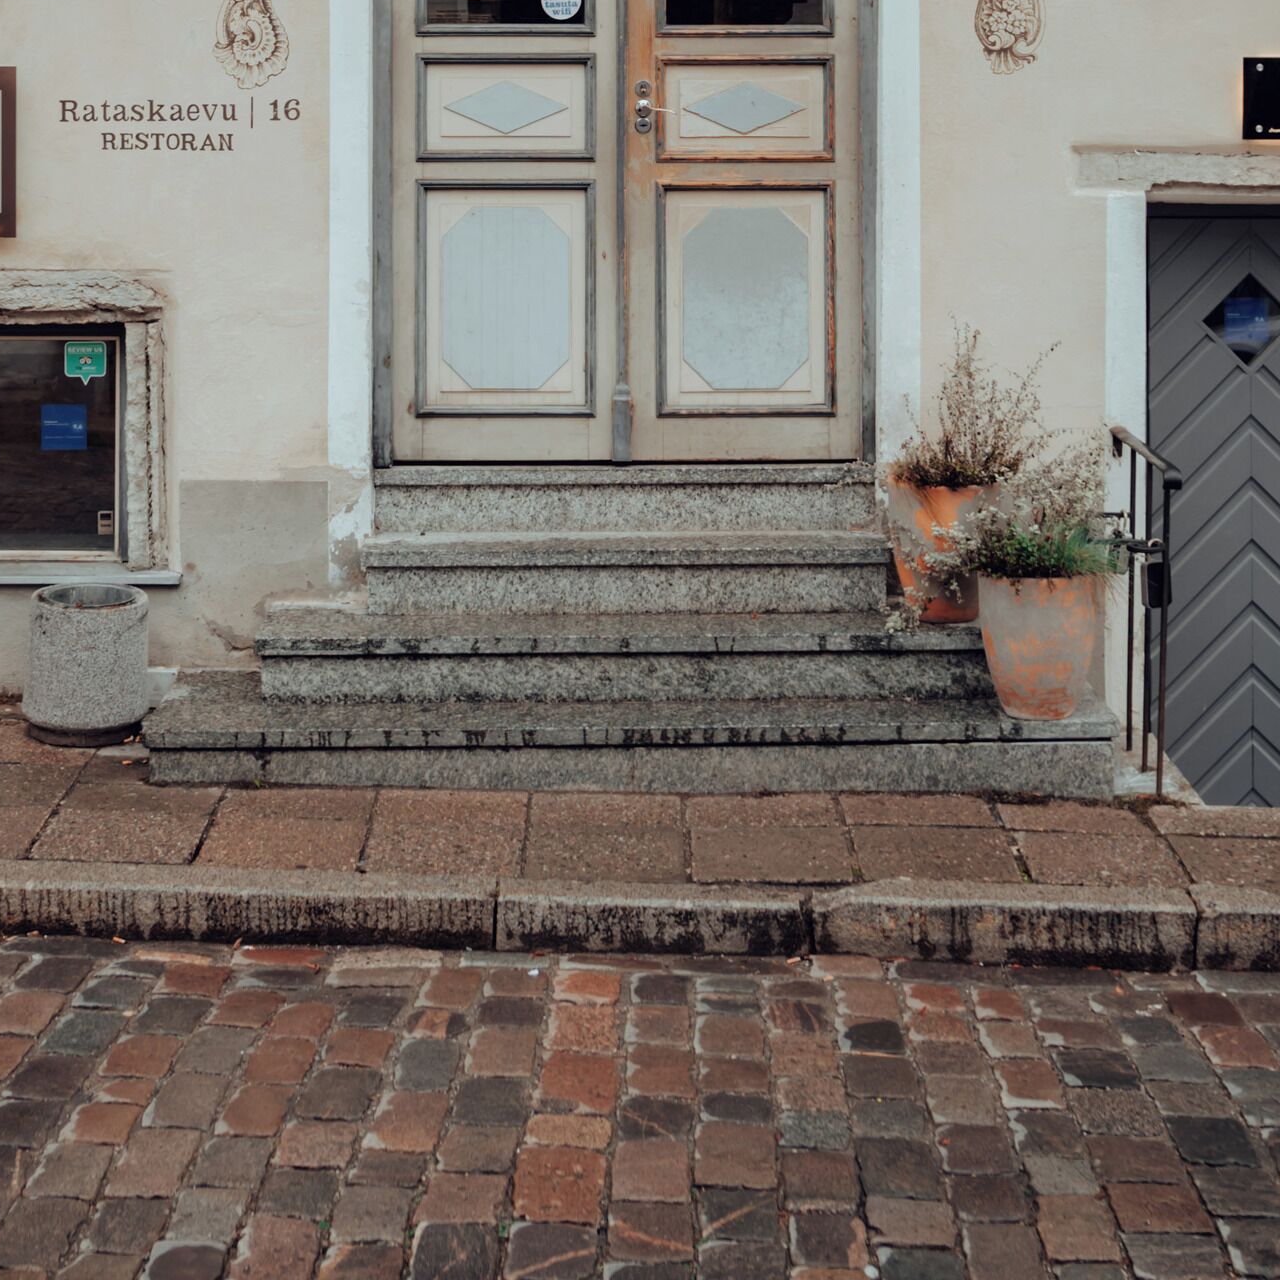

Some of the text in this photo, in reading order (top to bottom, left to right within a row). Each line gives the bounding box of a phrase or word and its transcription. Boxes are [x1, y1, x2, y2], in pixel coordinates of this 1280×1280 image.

[58, 99, 239, 122] Rataskaevu
[268, 98, 302, 121] 16
[100, 132, 235, 152] RESTORAN
